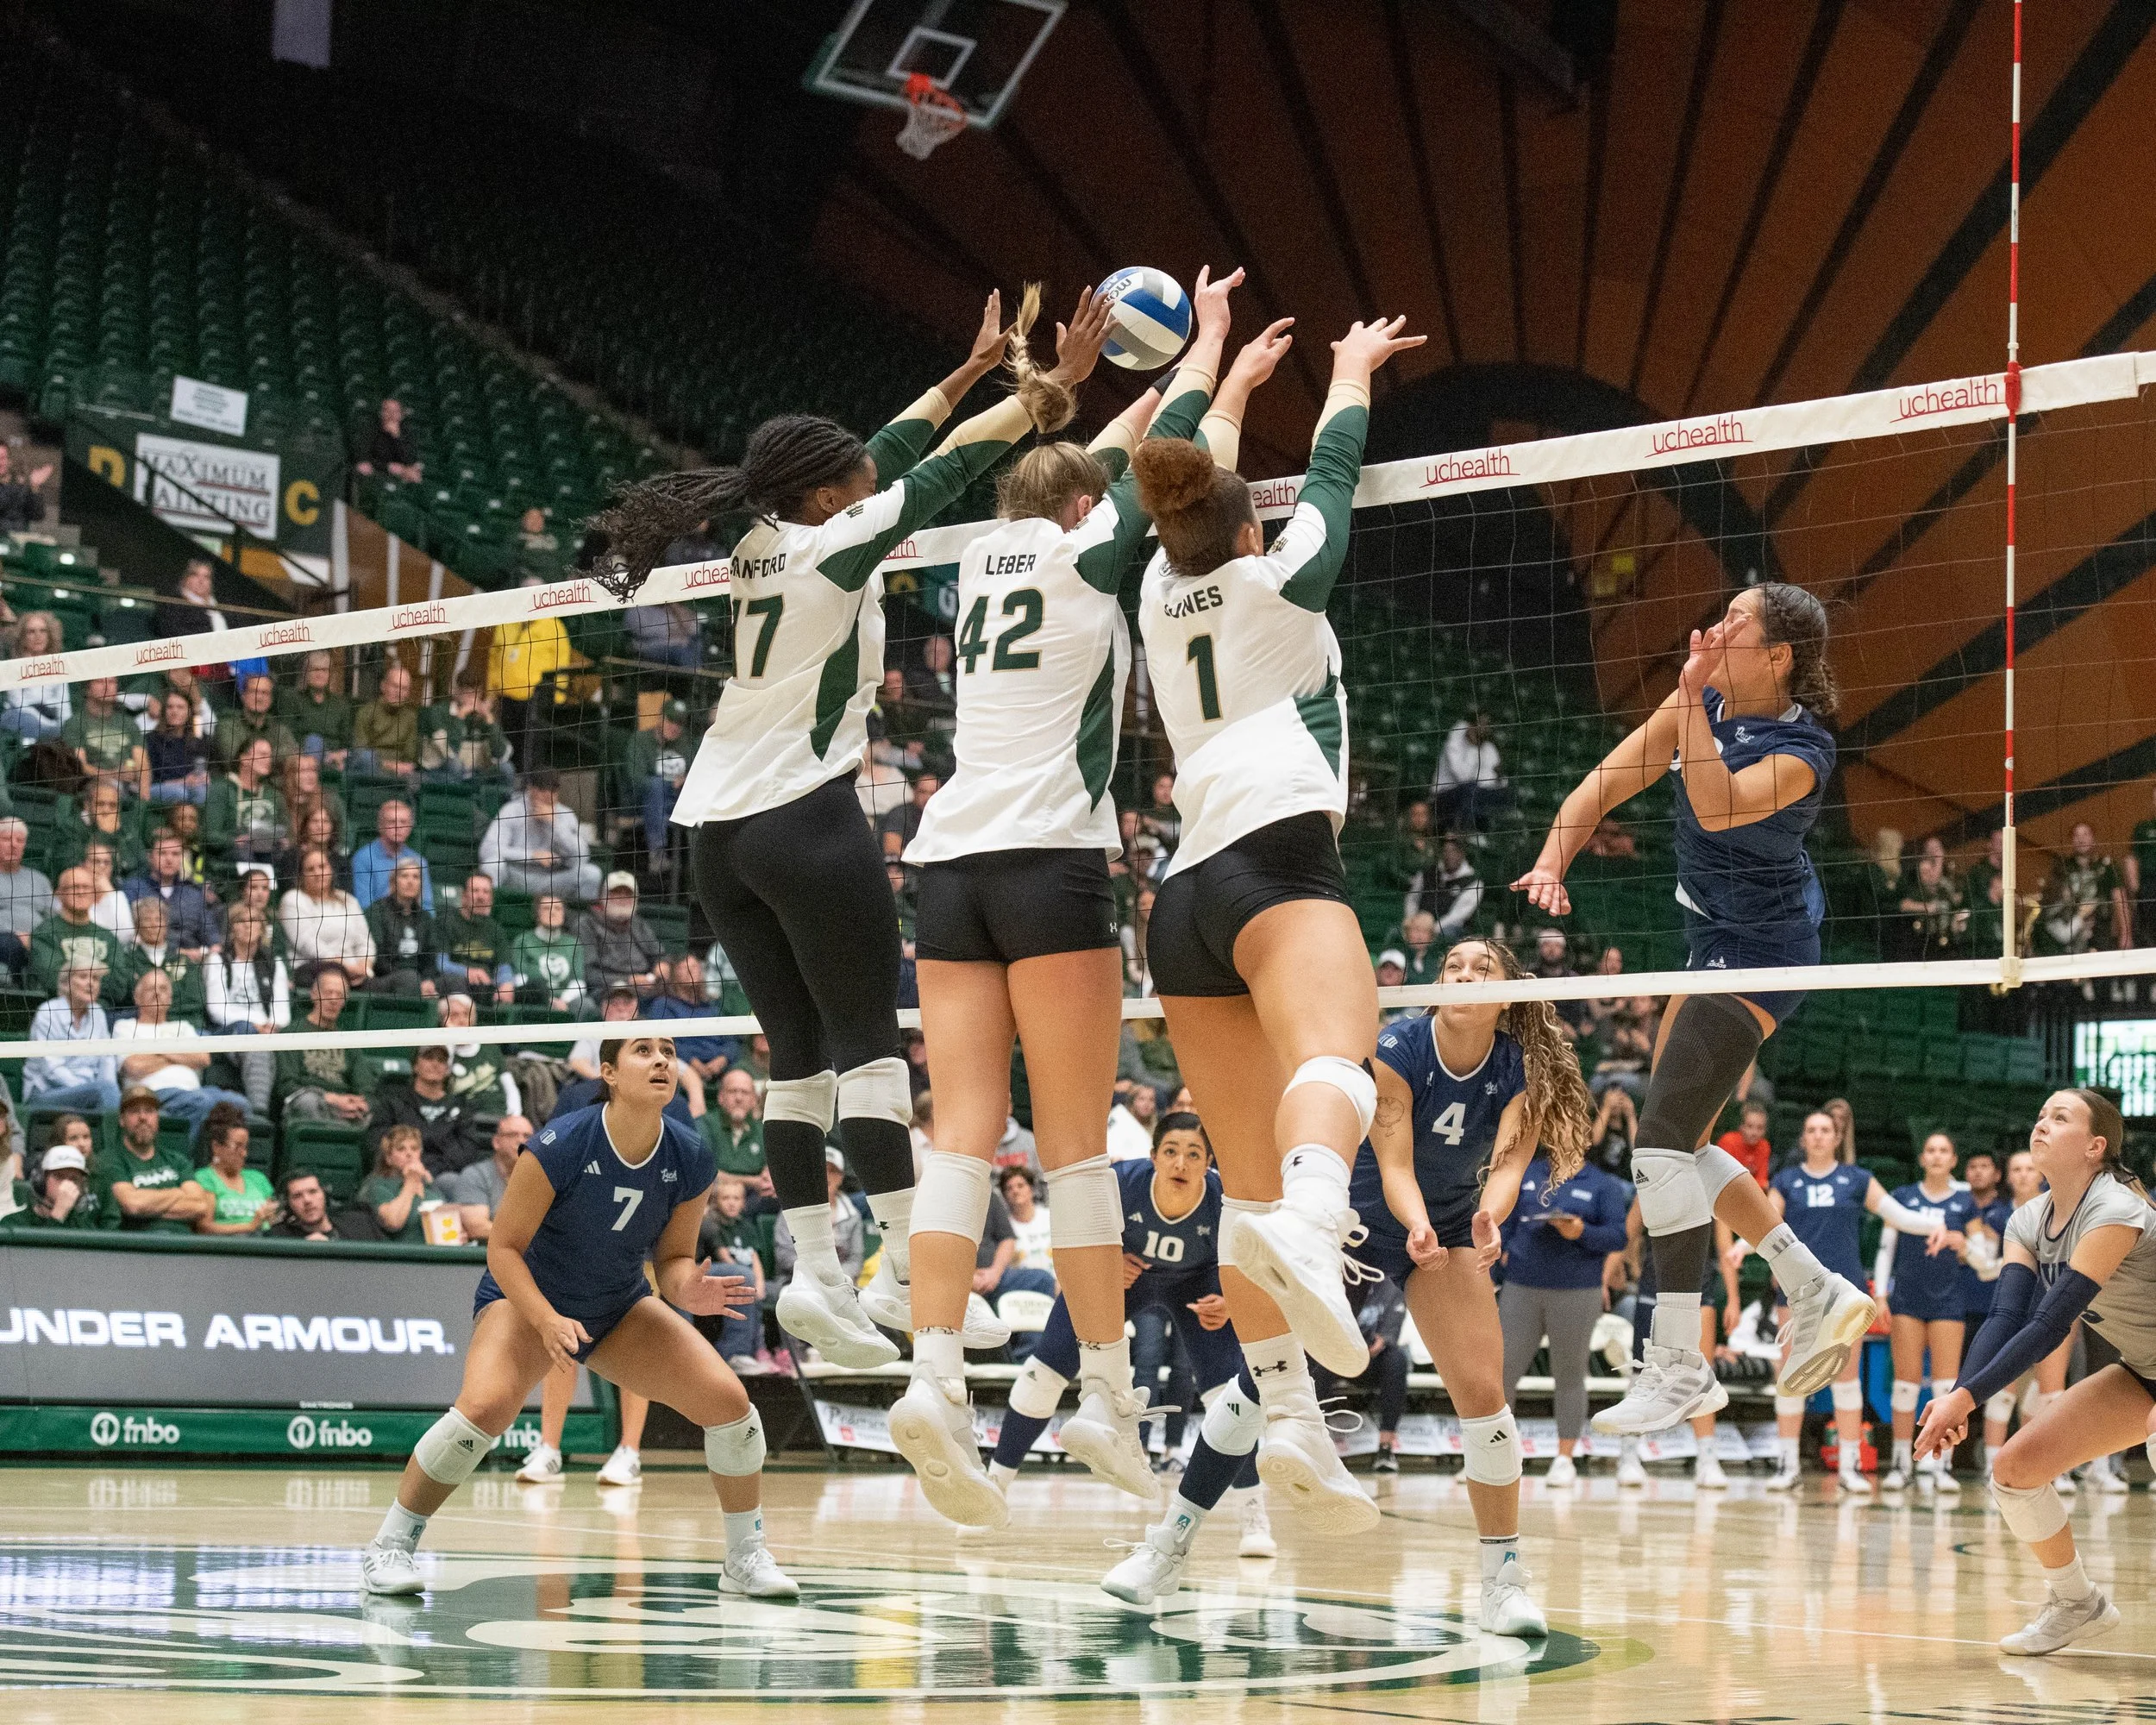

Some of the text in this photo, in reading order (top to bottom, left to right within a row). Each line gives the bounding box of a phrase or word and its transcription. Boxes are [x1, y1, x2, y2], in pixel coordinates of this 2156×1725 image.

[1899, 377, 1998, 418] uchealth
[1652, 414, 1745, 454] uchealth
[1426, 448, 1511, 485] uchealth
[144, 483, 272, 520] AINTING
[285, 479, 319, 525] C
[1253, 480, 1296, 508] ealth
[685, 562, 730, 588] uchea
[730, 552, 787, 579] ANFORD
[985, 553, 1037, 576] LEBER
[533, 580, 591, 610] uchealth
[392, 601, 446, 630] uchealth
[259, 621, 310, 648] uchealth
[957, 586, 1046, 676] 42
[135, 638, 184, 665] uchealth
[20, 657, 65, 680] uchealth
[1186, 631, 1224, 723] 1
[1432, 1101, 1467, 1145] 4
[611, 1186, 644, 1232] 7
[1806, 1183, 1835, 1208] 12
[1142, 1230, 1185, 1263] 10
[204, 1314, 455, 1353] ARMOUR.
[123, 1415, 181, 1444] fnbo
[318, 1419, 373, 1447] fnbo
[505, 1422, 541, 1449] fnb
